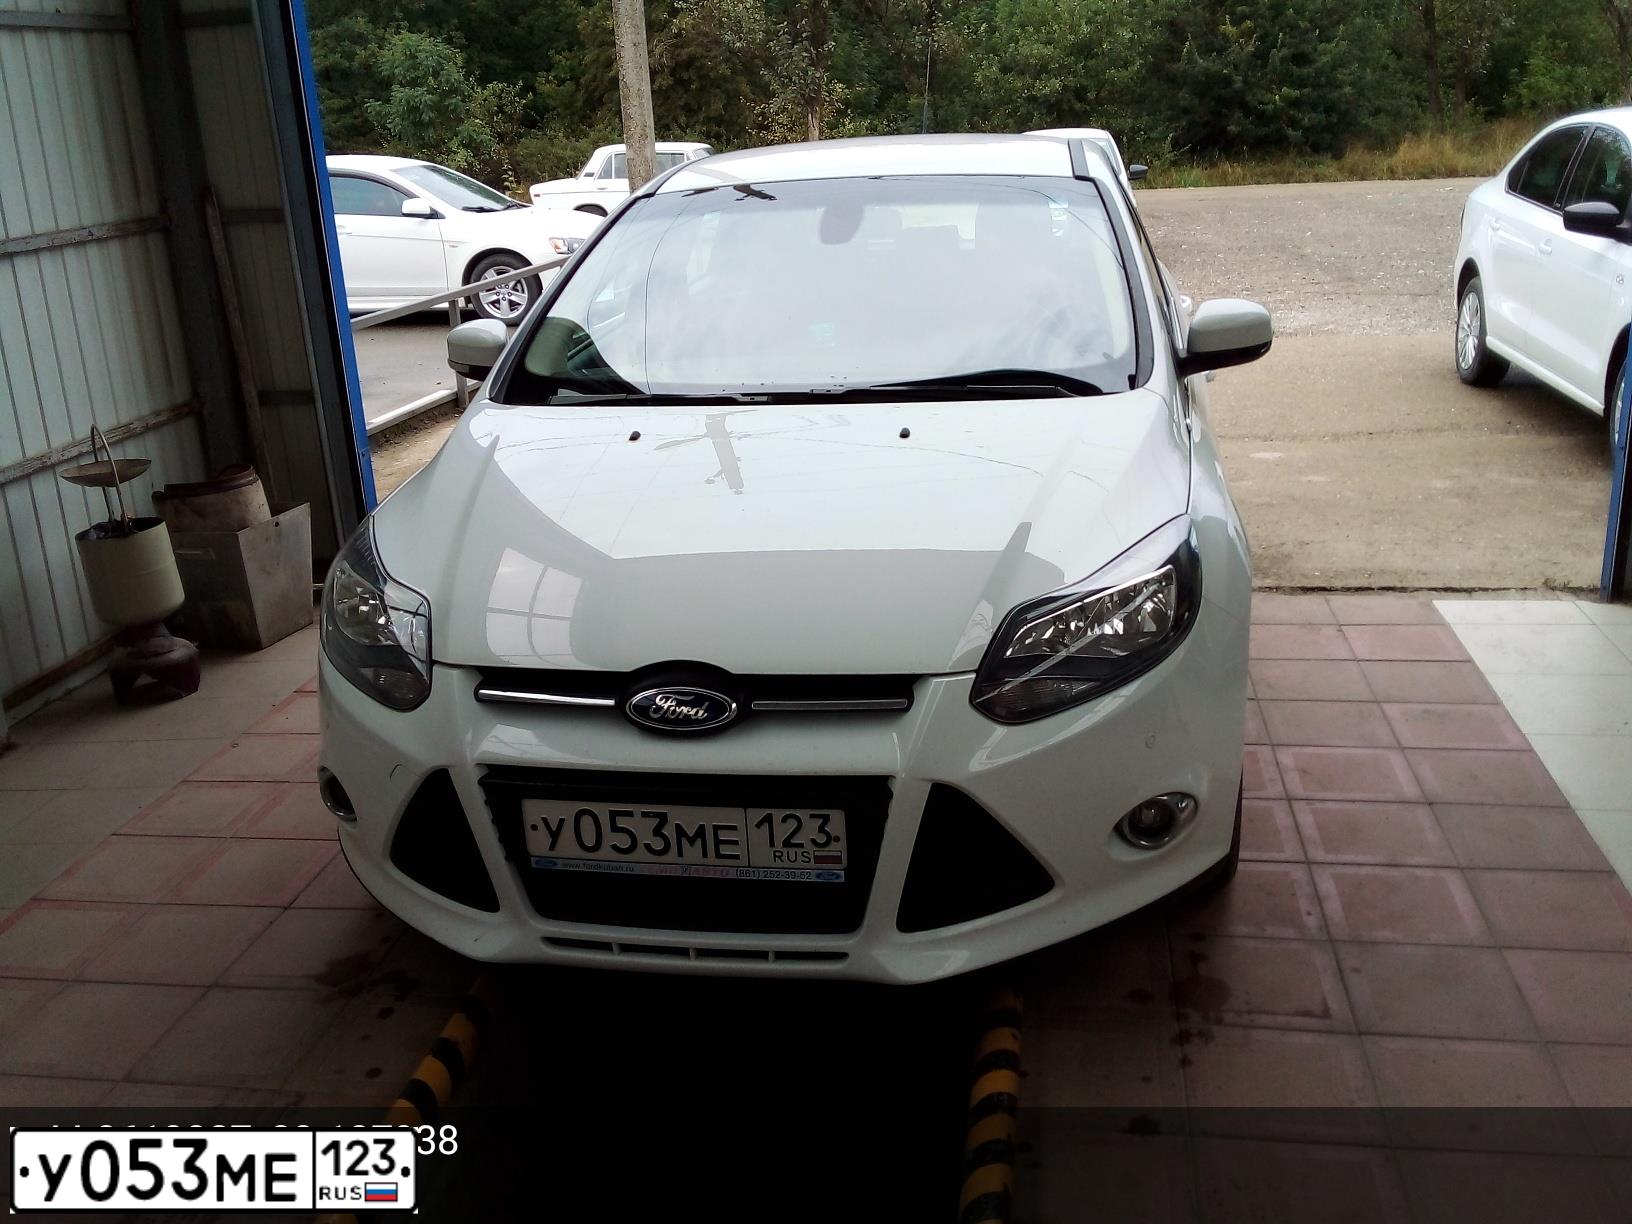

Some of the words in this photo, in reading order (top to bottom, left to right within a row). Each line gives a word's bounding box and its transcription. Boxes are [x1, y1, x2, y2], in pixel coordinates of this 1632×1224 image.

[649, 694, 709, 719] Ford
[754, 812, 833, 848] 123
[772, 849, 812, 863] RUS
[735, 869, 760, 880] (861)
[763, 870, 812, 880] 252-39-52
